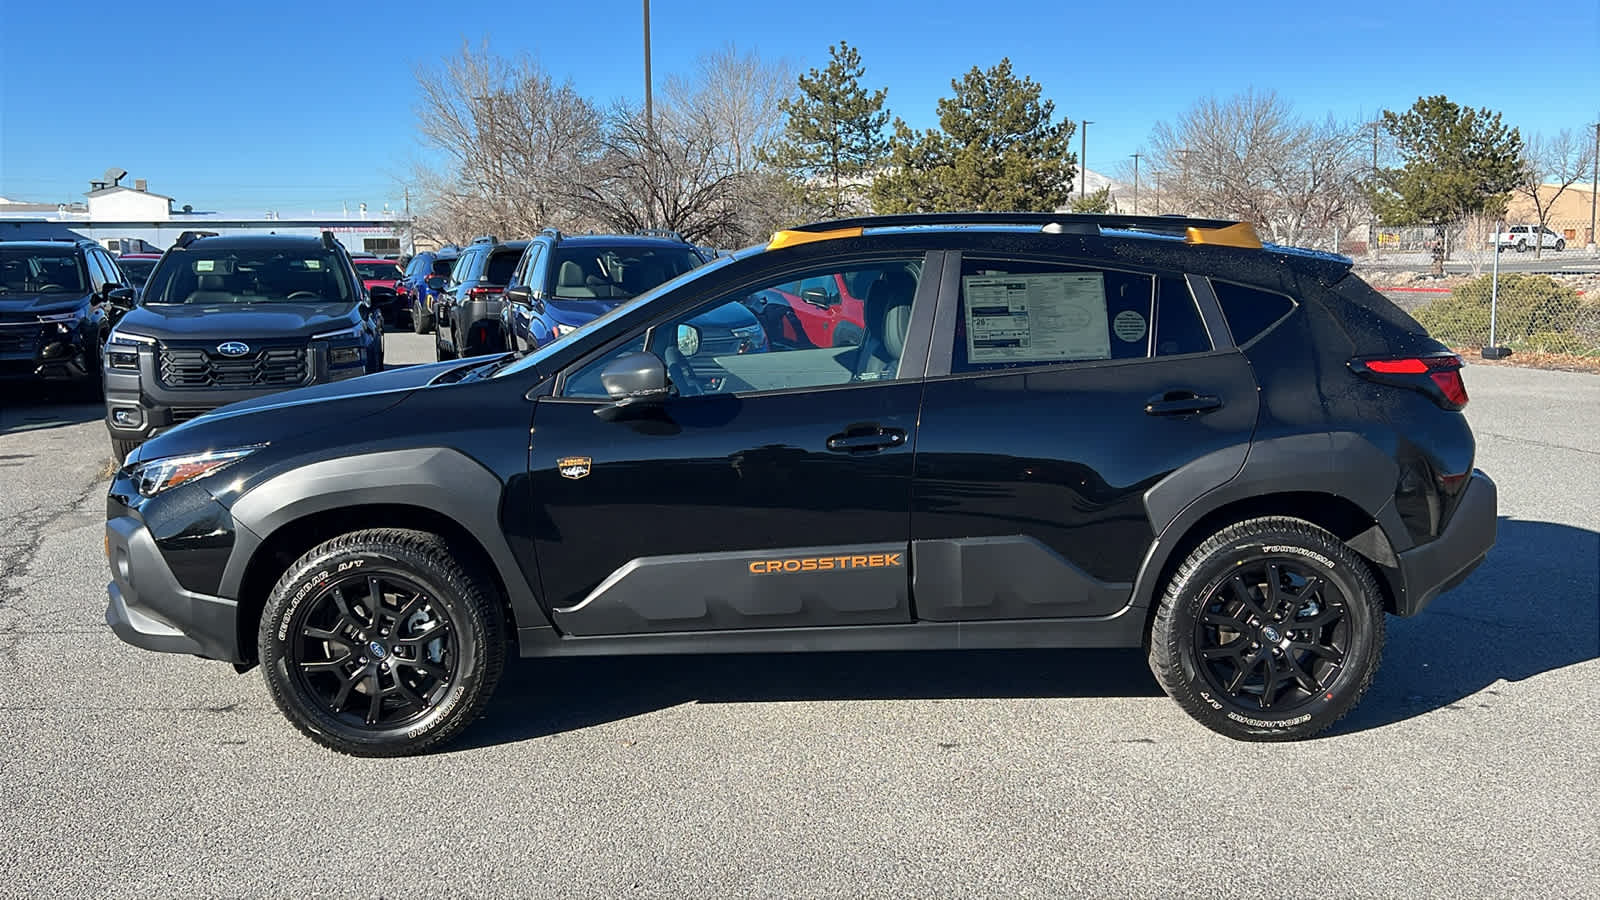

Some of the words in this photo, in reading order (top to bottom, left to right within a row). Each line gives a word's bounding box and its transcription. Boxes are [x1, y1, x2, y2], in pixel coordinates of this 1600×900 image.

[749, 553, 901, 573] CROSSTREK
[1262, 545, 1335, 568] YOKOHAMA
[278, 570, 329, 641] GEOLANDAR
[337, 559, 364, 572] A/T
